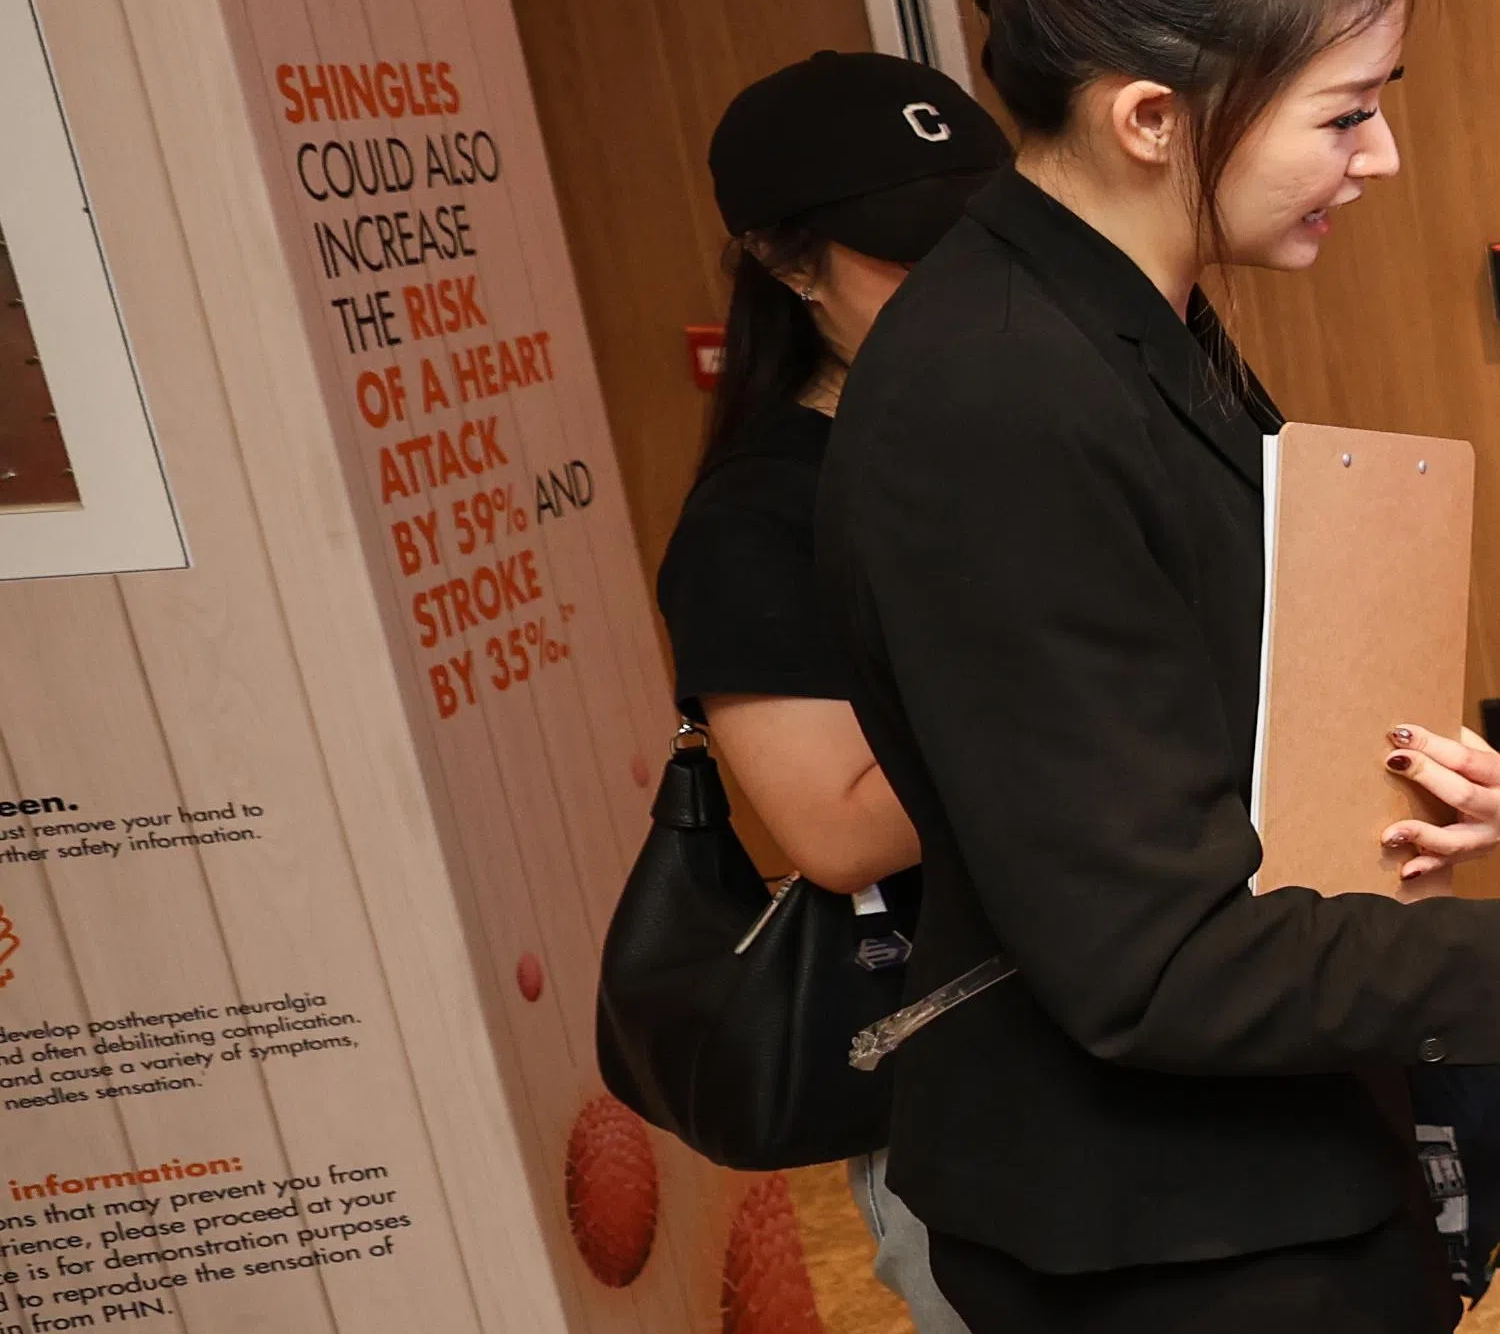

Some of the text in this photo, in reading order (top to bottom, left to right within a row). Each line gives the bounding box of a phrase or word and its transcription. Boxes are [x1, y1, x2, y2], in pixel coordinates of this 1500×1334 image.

[275, 61, 461, 124] SHINGLES
[903, 102, 951, 143] C
[297, 130, 499, 201] COULD ALSO
[314, 204, 476, 279] INCREASE
[331, 274, 487, 354] THE RISK
[356, 331, 555, 429] OF A HEART
[379, 415, 508, 505] ATTACK
[391, 460, 594, 577] BY 59% AND
[412, 548, 542, 649] STROKE
[428, 650, 476, 720] BY
[33, 802, 236, 837] remove hand
[58, 826, 262, 859] safety information.
[88, 992, 327, 1037] postherpetic neuralgia
[93, 1010, 362, 1056] debilitating complication.
[140, 1033, 359, 1072] variety symptoms,
[4, 1085, 90, 1112] needles
[8, 1156, 243, 1202] information:
[169, 1179, 267, 1212] prevent
[100, 1199, 300, 1250] please proceed
[104, 1212, 412, 1271] demonstration purposes
[53, 1245, 362, 1307] reproduce sensation
[103, 1298, 174, 1324] PHN.
